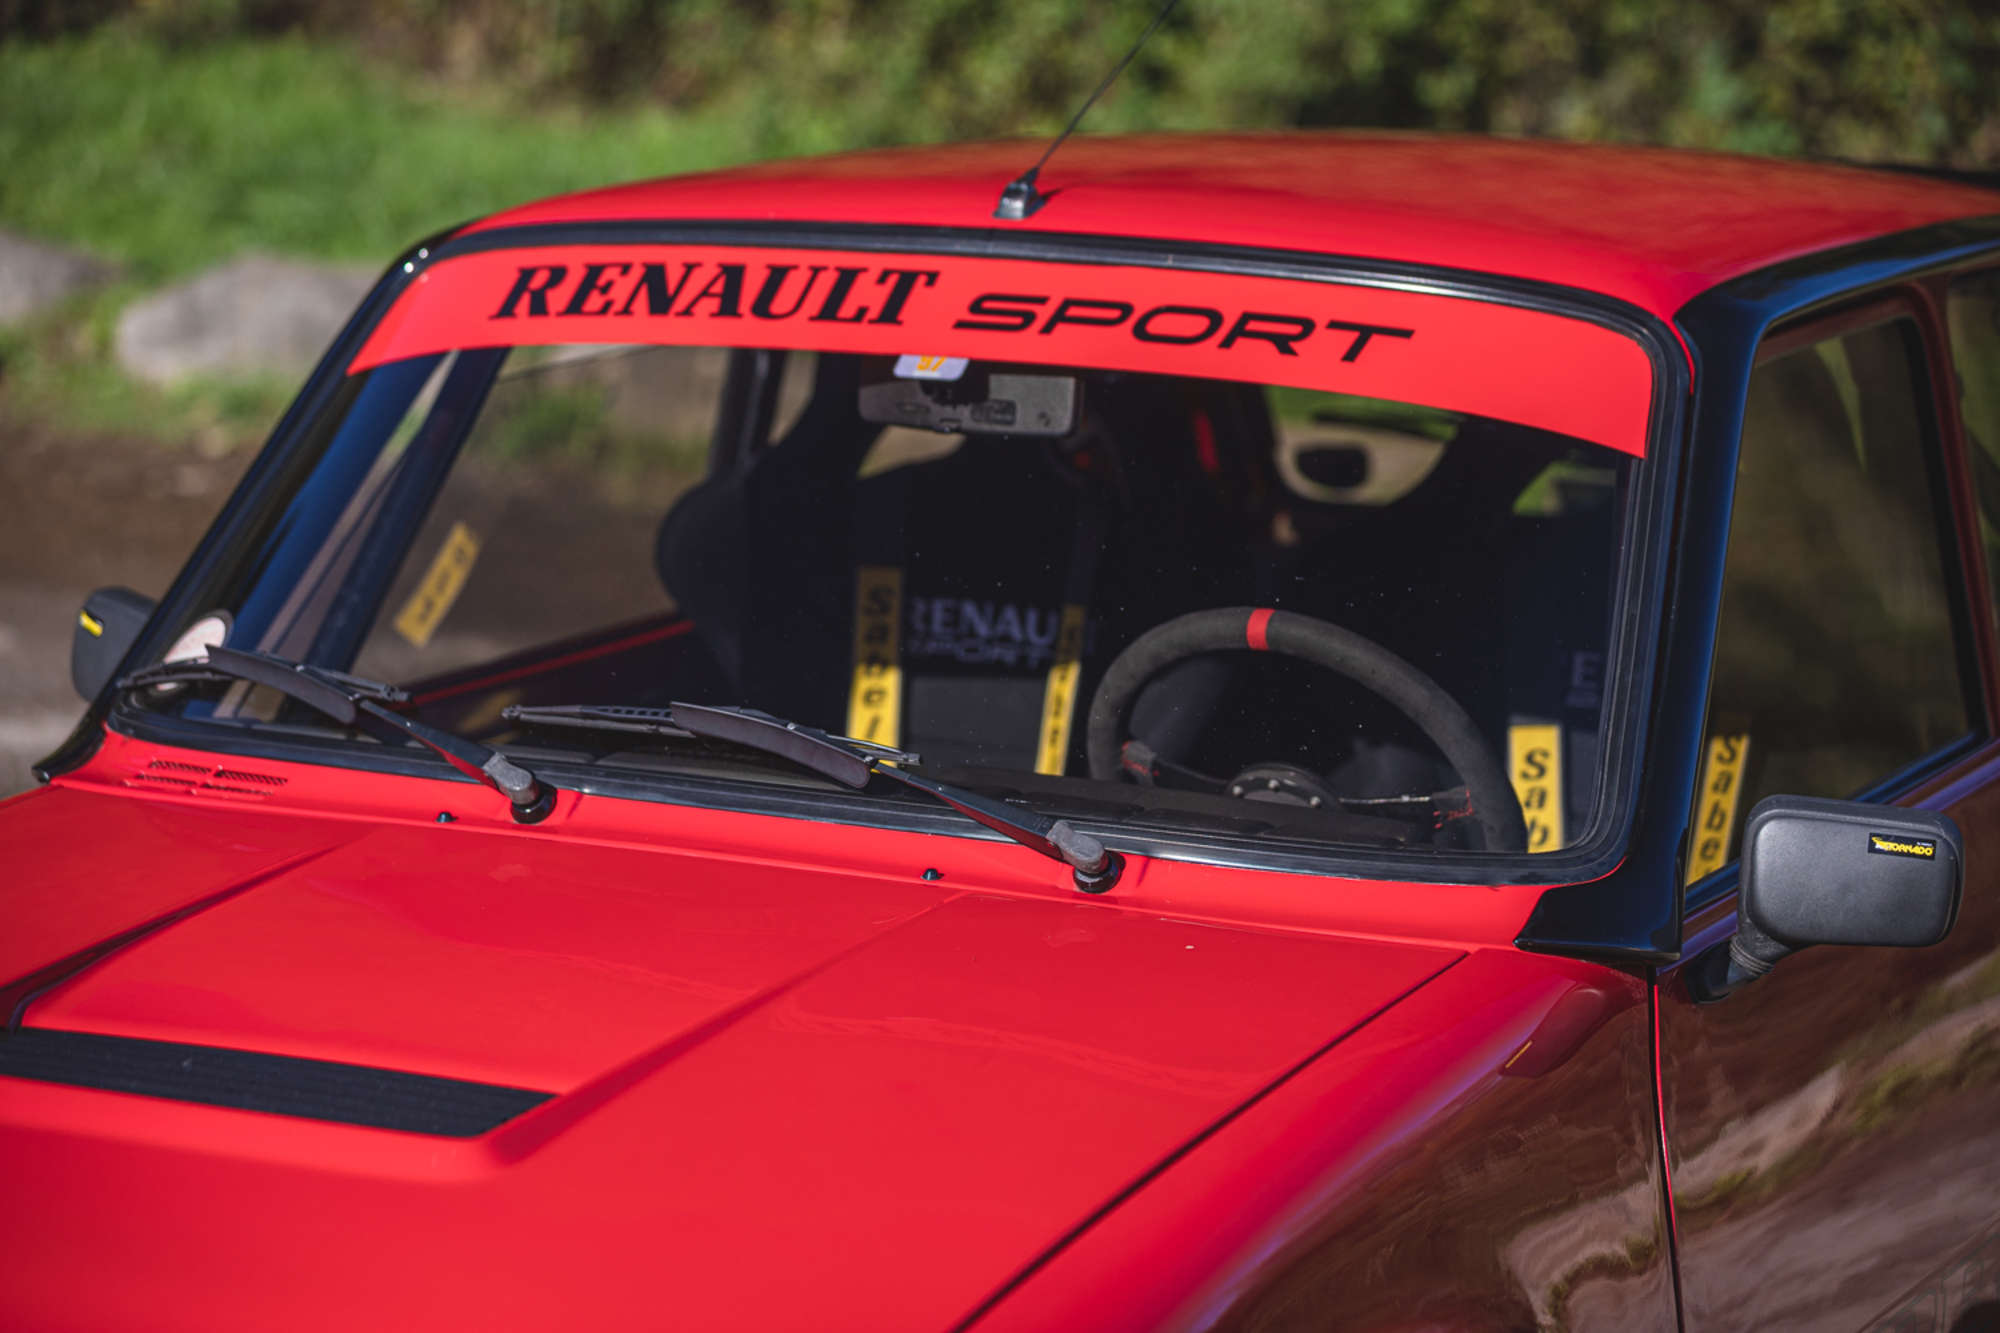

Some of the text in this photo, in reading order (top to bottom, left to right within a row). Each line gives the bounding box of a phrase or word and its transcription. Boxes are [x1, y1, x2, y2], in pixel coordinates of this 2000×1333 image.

[489, 262, 1415, 363] RENAULT SPORT
[1520, 747, 1551, 847] Sab
[1701, 734, 1743, 866] Sabe
